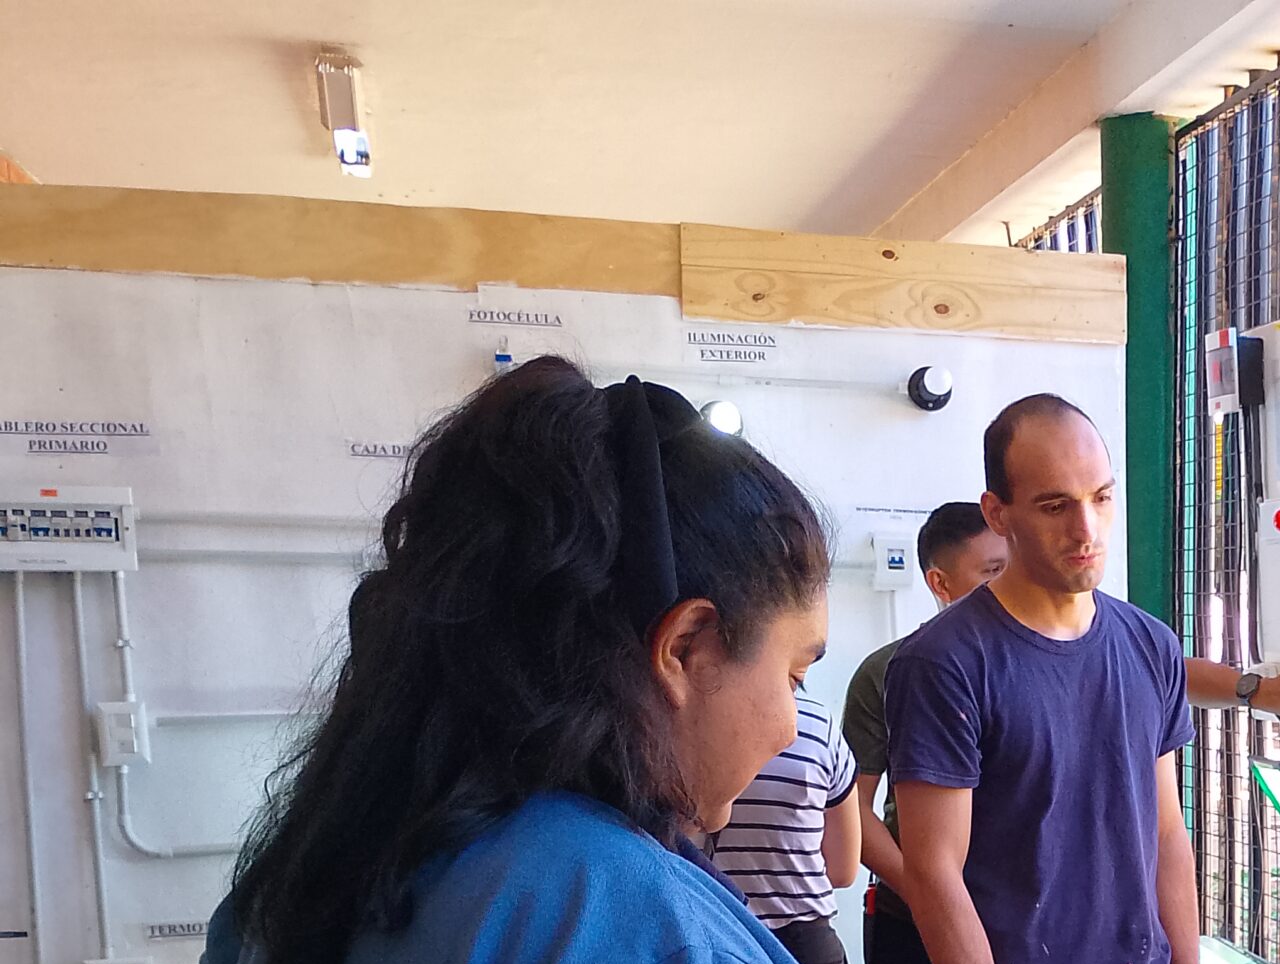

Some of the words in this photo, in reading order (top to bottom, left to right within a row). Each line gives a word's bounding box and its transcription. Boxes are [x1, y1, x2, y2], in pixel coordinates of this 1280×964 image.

[468, 309, 562, 325] FOTOCÉLULA
[687, 332, 776, 345] ILUMINACIÓN
[700, 349, 767, 361] EXTERIOR
[60, 422, 149, 434] SECCIONAL
[28, 440, 107, 451] PRIMARIO
[351, 444, 388, 455] CAJA
